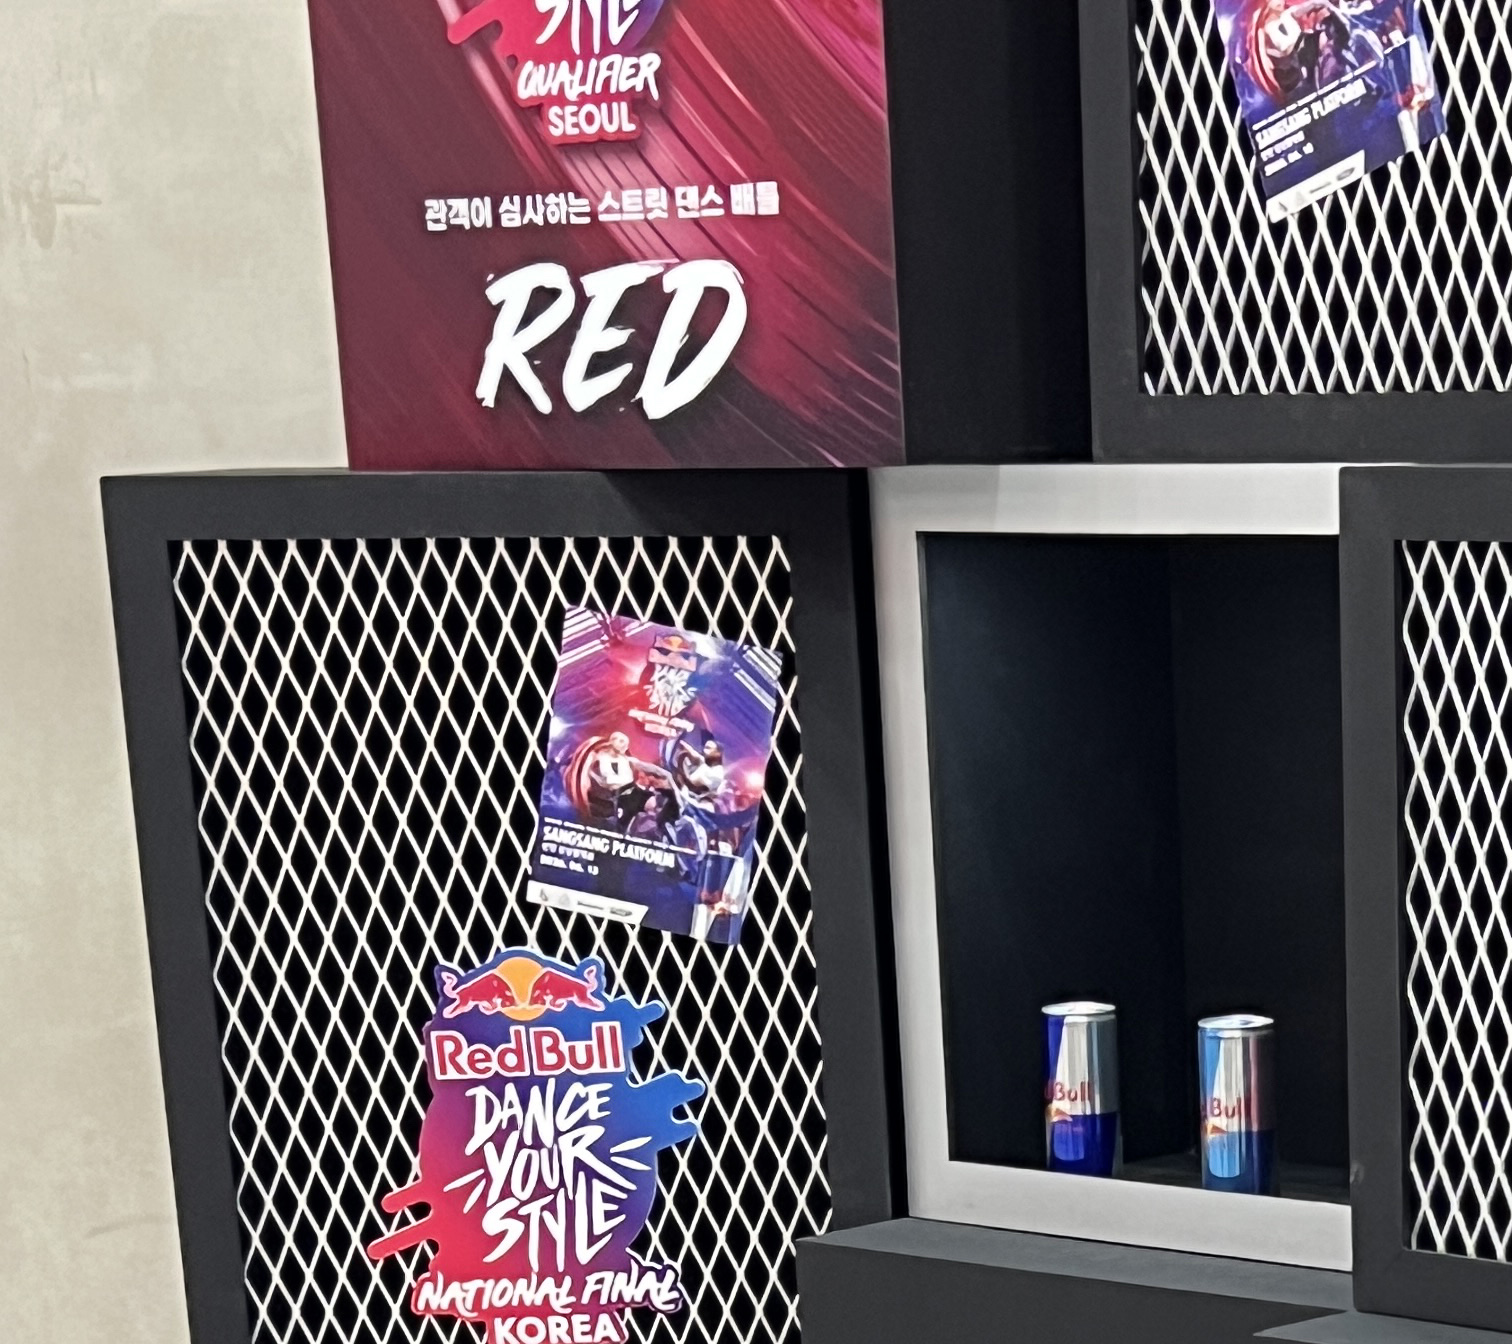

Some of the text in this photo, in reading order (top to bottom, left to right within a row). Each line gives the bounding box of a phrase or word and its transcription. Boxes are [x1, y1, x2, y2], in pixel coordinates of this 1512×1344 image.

[517, 52, 661, 101] QUALIFIER
[548, 101, 636, 137] SEOUL
[425, 197, 492, 231] 관객이
[498, 193, 590, 227] 심사하는
[598, 188, 668, 222] 스트릿
[675, 185, 724, 219] 댄스
[475, 259, 748, 420] RED
[612, 839, 675, 868] PLATFORM
[431, 1021, 625, 1079] Red Bull
[466, 1078, 612, 1155] DANCE
[484, 1125, 636, 1206] YOUR
[482, 1173, 630, 1272] STYLE
[418, 1265, 679, 1318] NATIONAL FINAL
